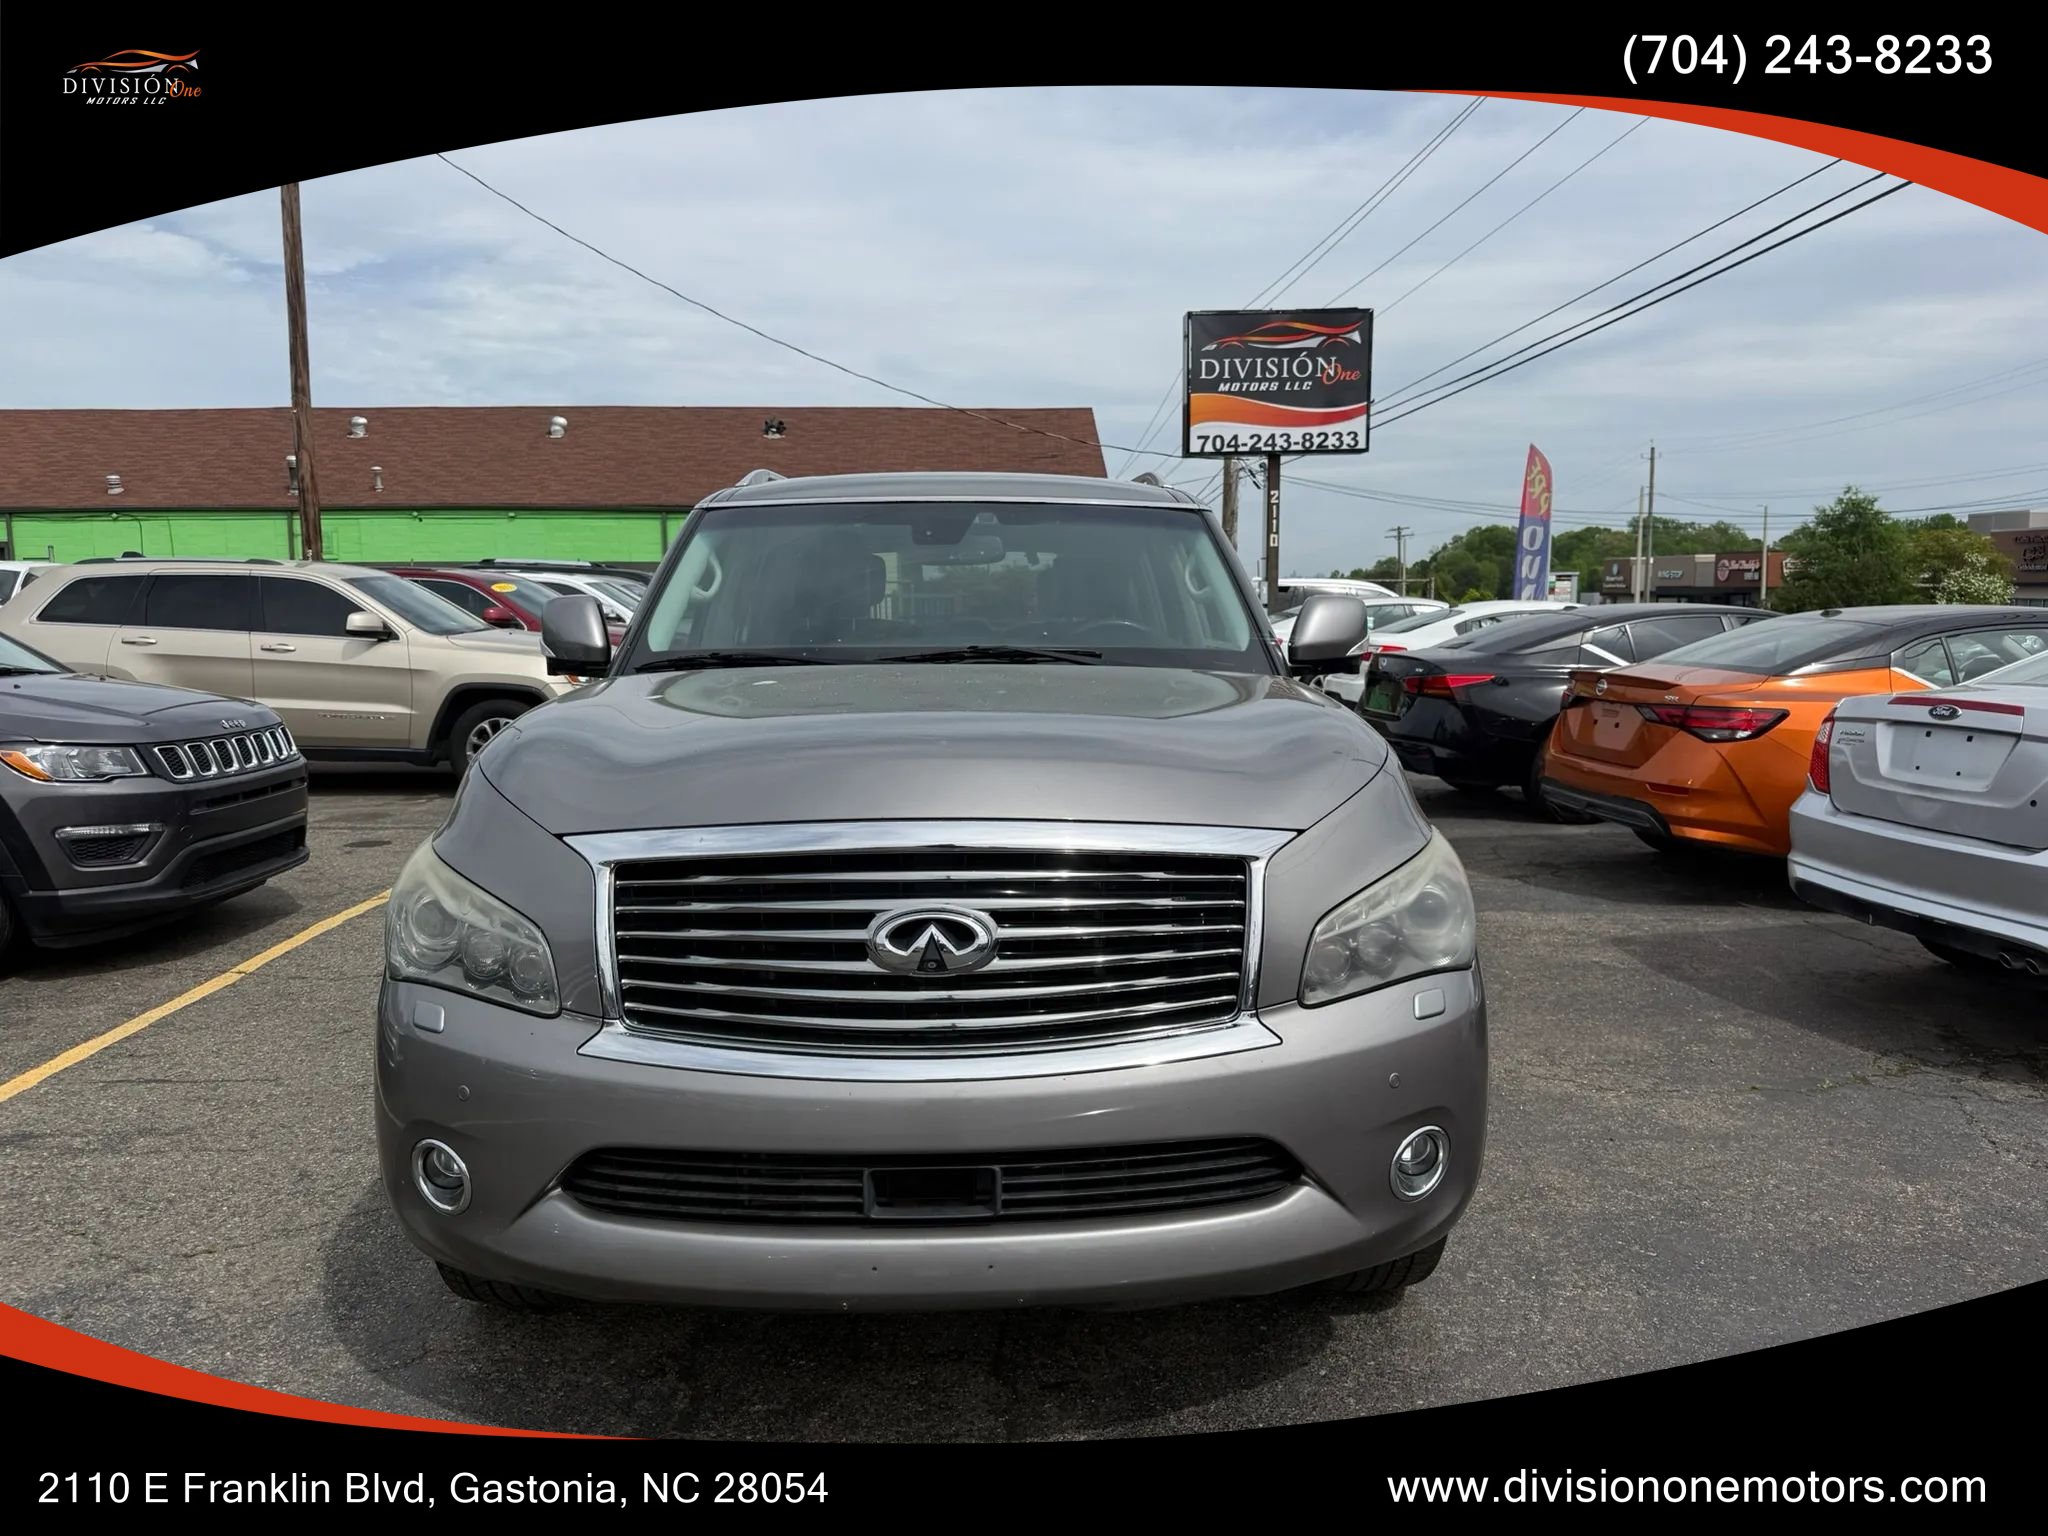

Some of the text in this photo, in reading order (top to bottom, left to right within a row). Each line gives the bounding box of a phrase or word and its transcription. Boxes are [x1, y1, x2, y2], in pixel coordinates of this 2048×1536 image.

[1200, 351, 1361, 385] DIVISIÓN One
[1218, 381, 1313, 392] MOTORS LLC
[1196, 431, 1360, 453] 704-243-8233
[1269, 490, 1280, 548] 2110
[1932, 705, 1953, 717] Ford
[221, 719, 247, 730] Jeep
